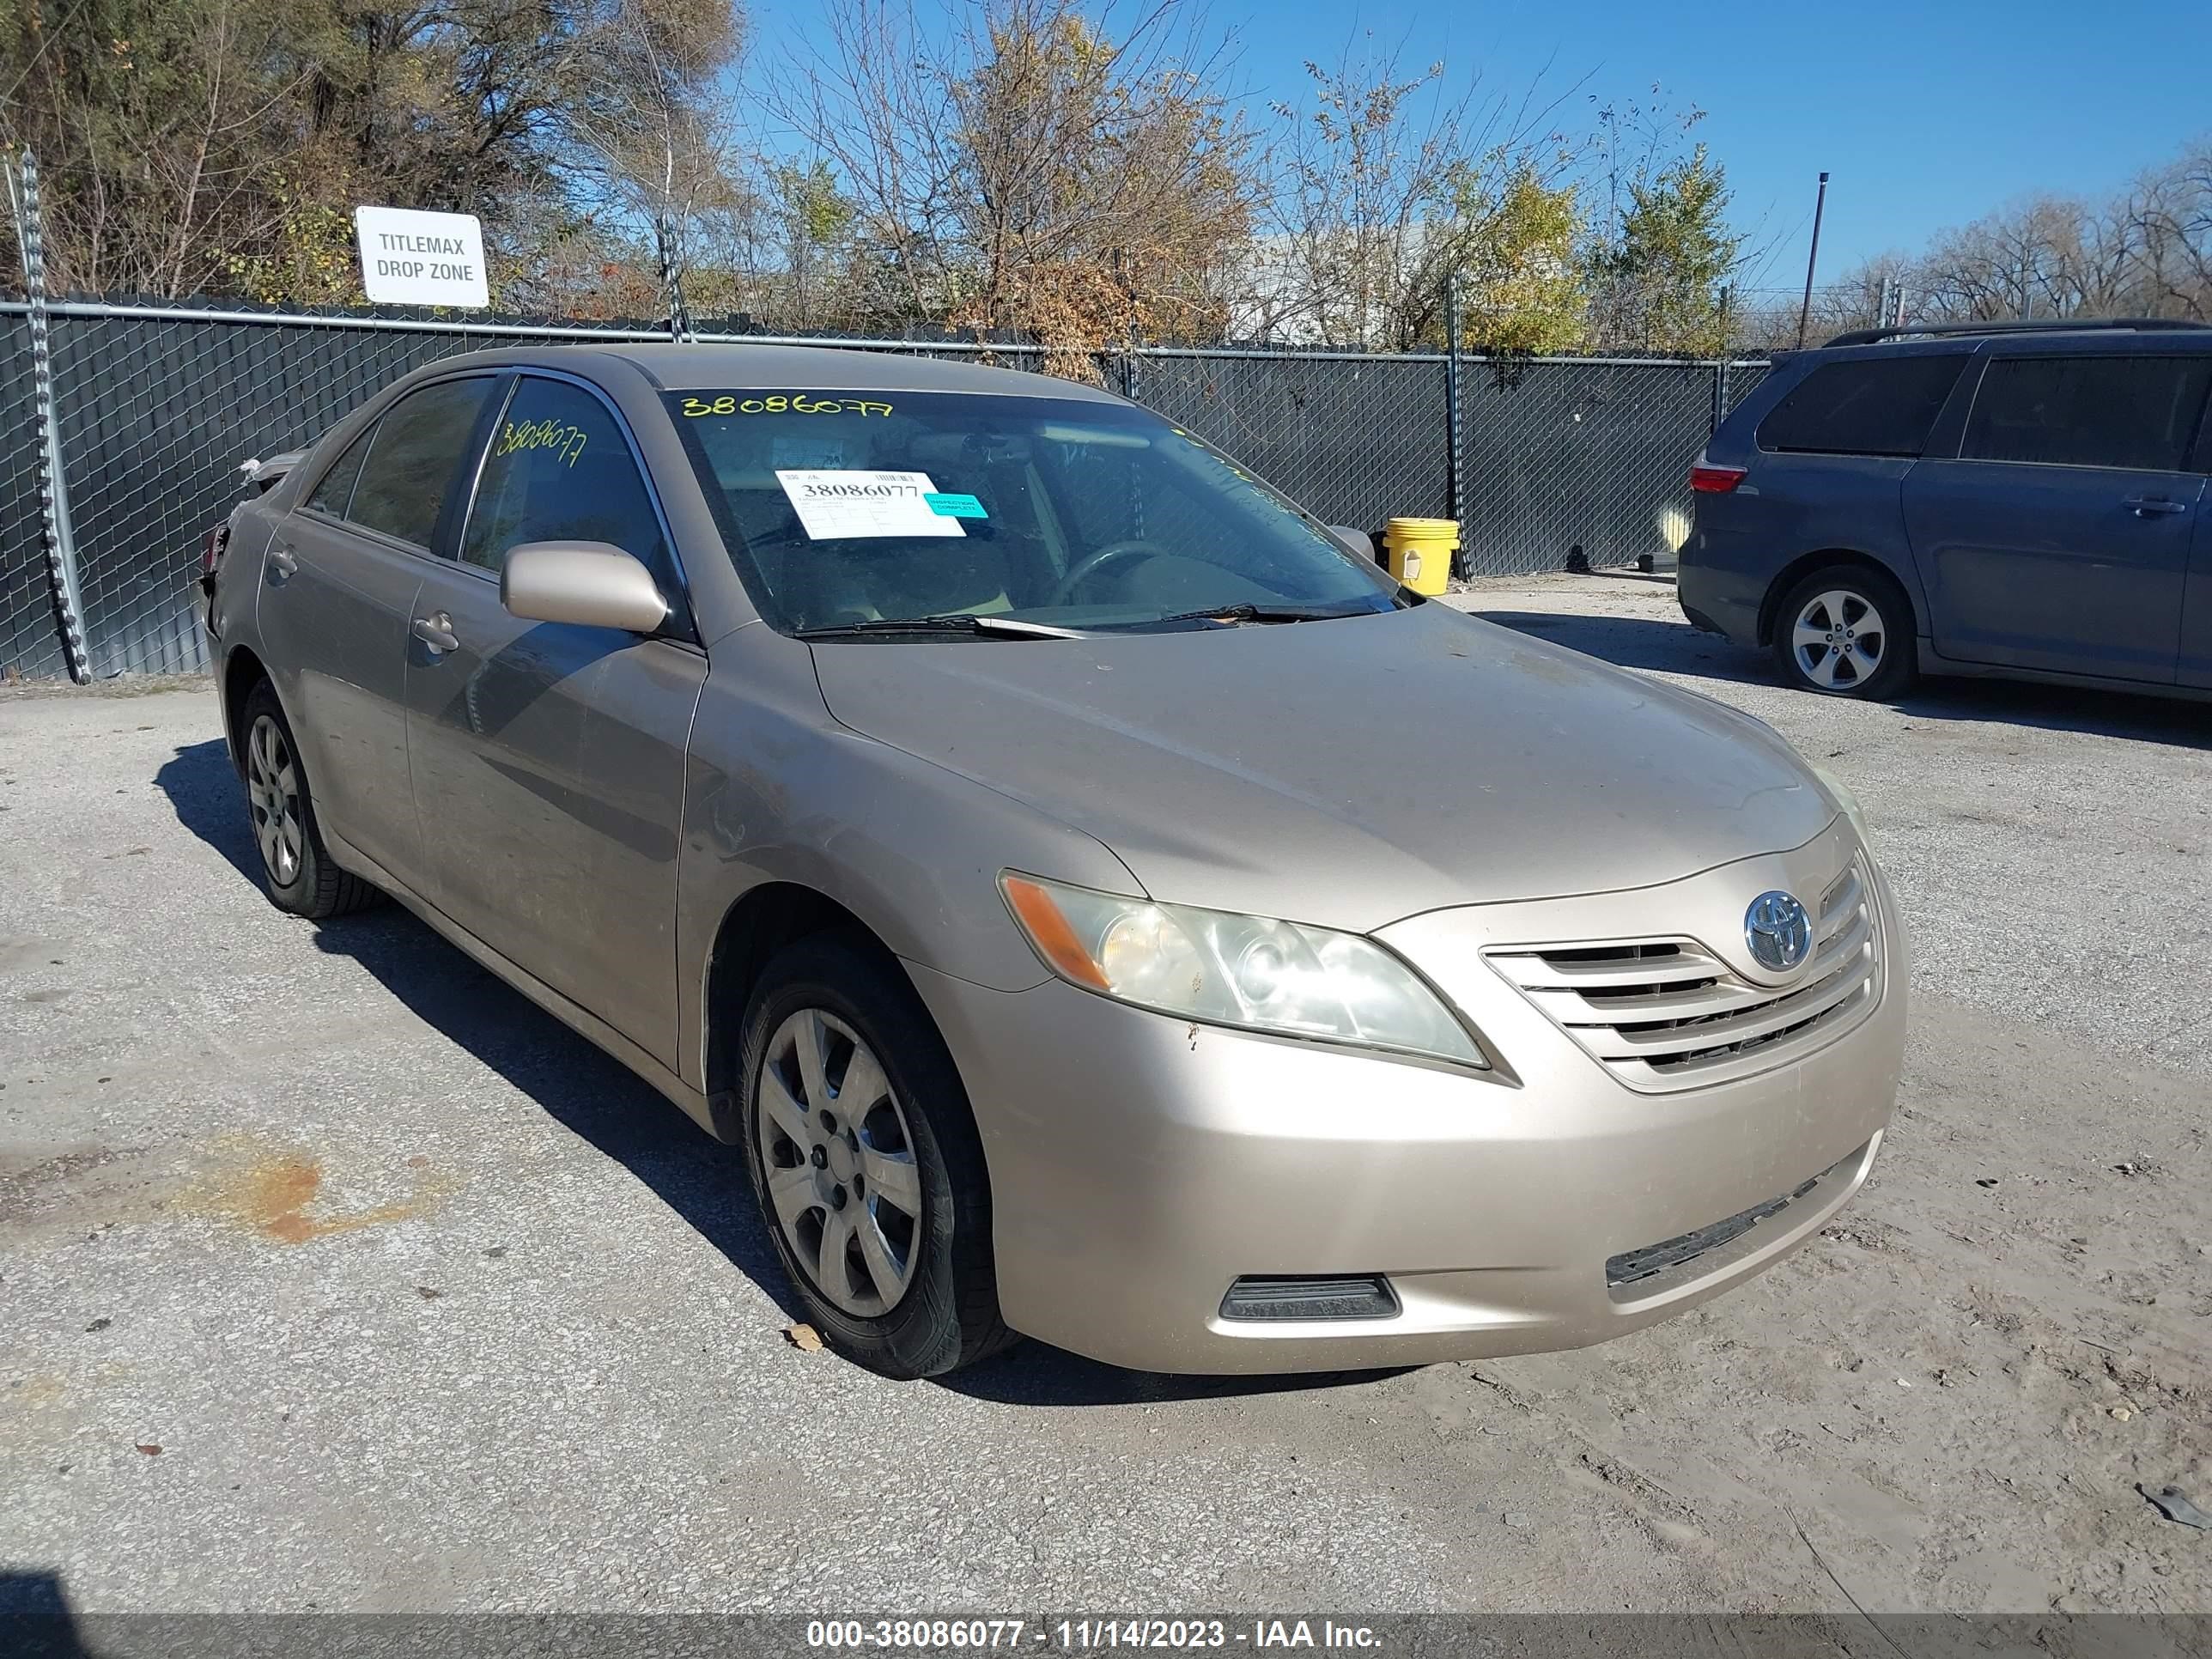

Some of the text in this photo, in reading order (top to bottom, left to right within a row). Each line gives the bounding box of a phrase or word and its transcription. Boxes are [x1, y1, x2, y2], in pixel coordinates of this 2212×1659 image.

[379, 233, 465, 255] TITLEMAX
[377, 259, 474, 282] DROP ZONE
[680, 394, 894, 417] 38086077
[496, 419, 587, 468] 38086077
[801, 483, 918, 498] 38086077
